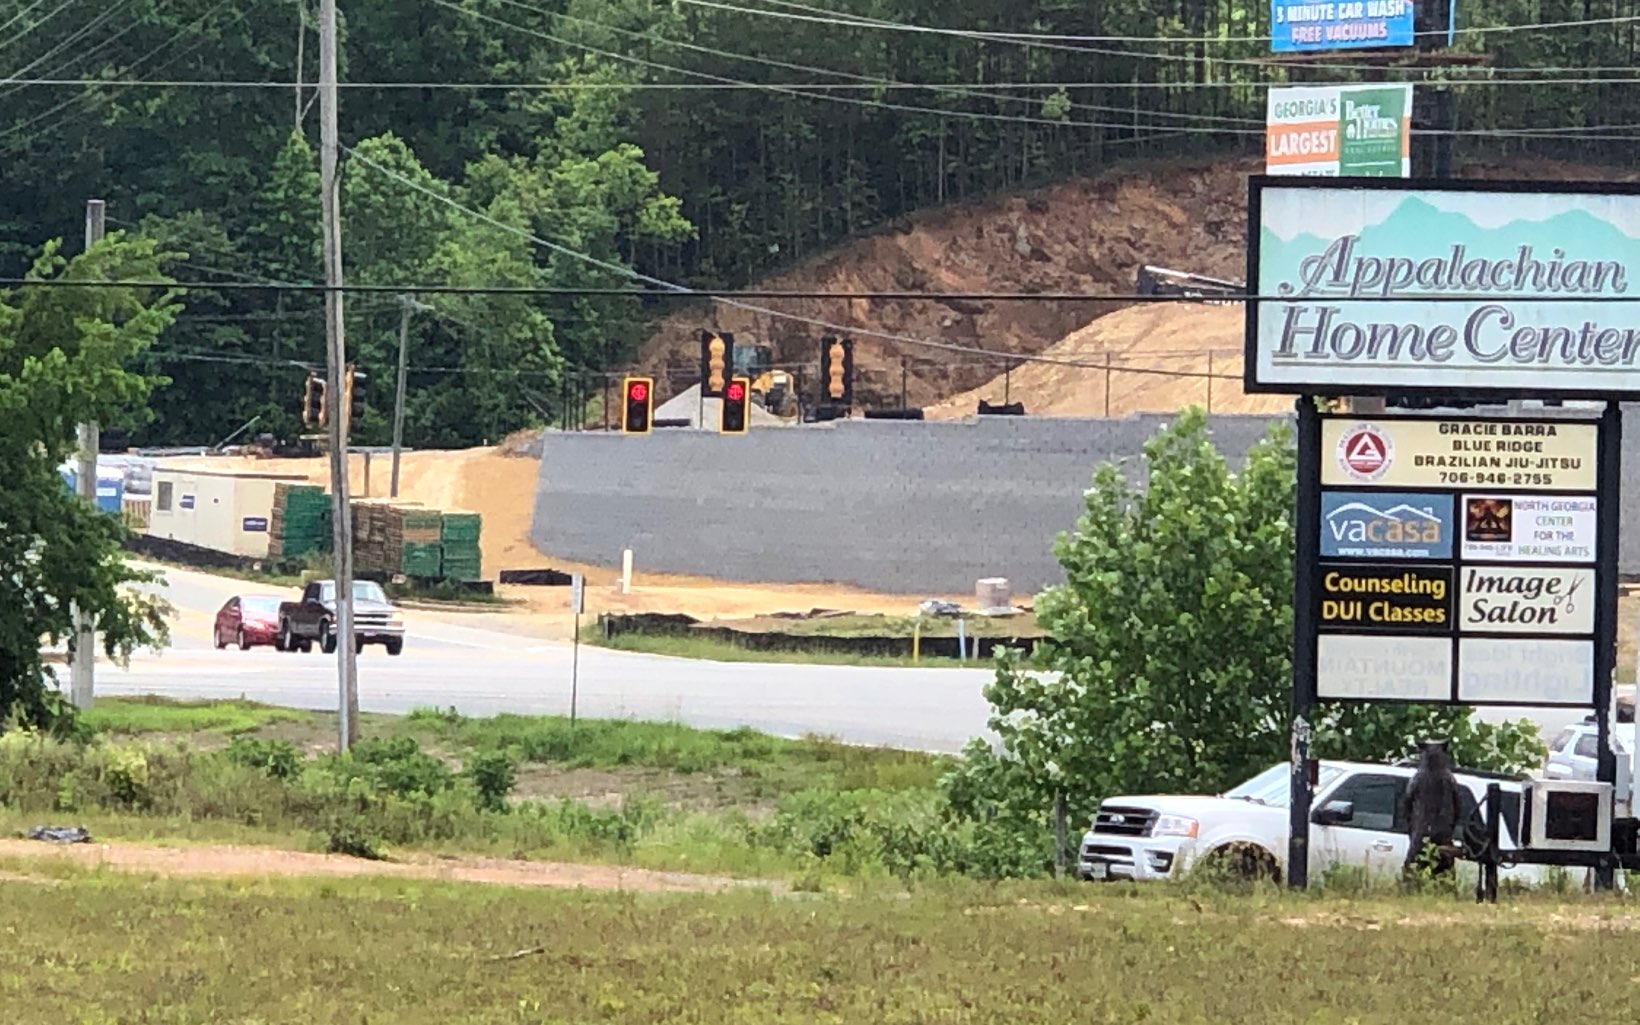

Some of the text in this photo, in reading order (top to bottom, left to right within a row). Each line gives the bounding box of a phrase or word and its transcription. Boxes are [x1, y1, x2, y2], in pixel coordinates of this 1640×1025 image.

[1287, 4, 1335, 22] MINUTE
[1338, 2, 1364, 19] CAR
[1368, 1, 1405, 17] WASH
[1291, 22, 1387, 43] FREE VACUUMS
[1274, 98, 1336, 119] GEORGIA'S
[1271, 129, 1337, 157] LARGEST
[1277, 235, 1629, 297] Appalachian
[1272, 305, 1457, 361] Home
[1439, 423, 1557, 436] GRACIE BARRA
[1452, 440, 1543, 453] BLUE RIDGE
[1414, 455, 1581, 469] BRAZILIAN JIU-JITSU
[1514, 501, 1595, 512] NORTH GEORGIA
[1329, 519, 1441, 543] vacasa
[1535, 516, 1573, 526] CENTER
[1534, 530, 1575, 541] FOR THE
[1518, 545, 1561, 556] HEALING
[1564, 546, 1590, 556] ARTS
[1324, 572, 1446, 600] Counseling
[1465, 569, 1562, 600] Image
[1322, 601, 1446, 623] DUI Classes
[1467, 598, 1558, 625] Salon
